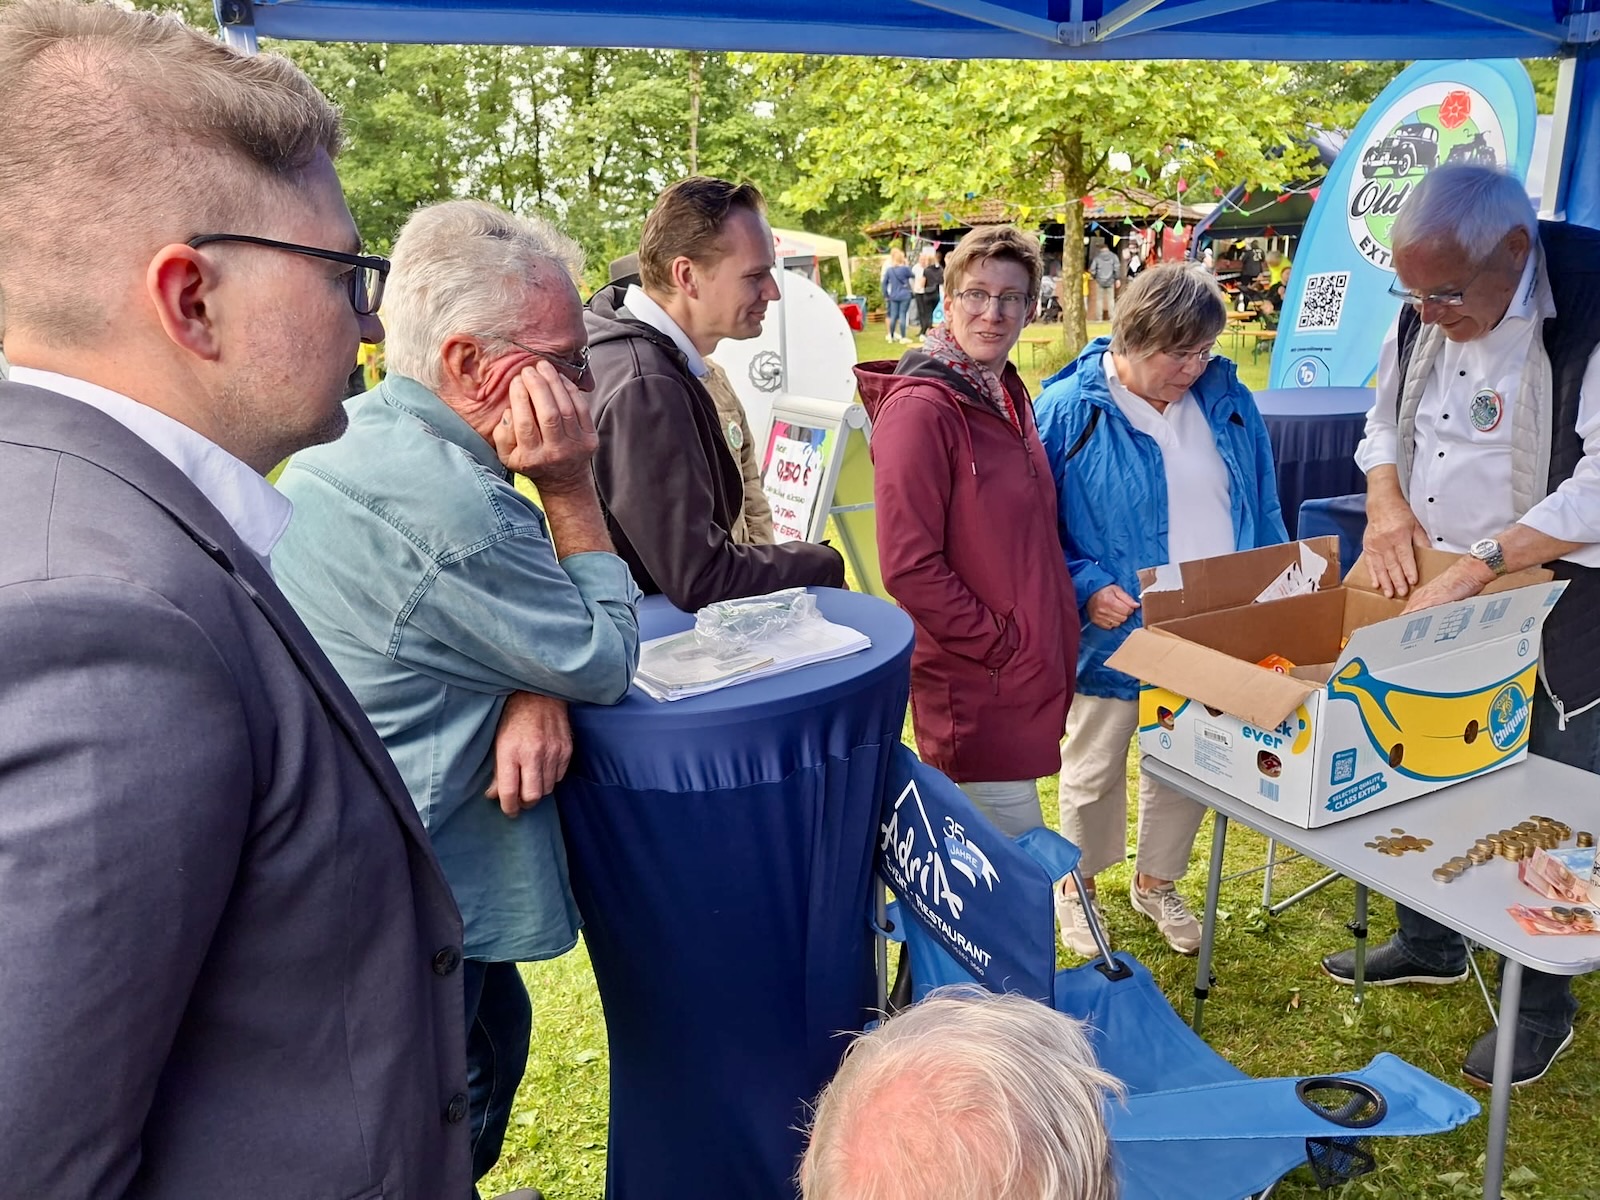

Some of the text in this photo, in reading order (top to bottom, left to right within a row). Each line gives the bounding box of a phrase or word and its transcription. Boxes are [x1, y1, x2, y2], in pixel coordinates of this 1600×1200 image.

[1242, 726, 1283, 749] ever
[1493, 704, 1529, 747] Chiquita
[1332, 775, 1381, 802] SELECTED QUALITY
[1334, 782, 1381, 810] CLASS EXTRA
[943, 816, 965, 846] 35
[950, 844, 979, 869] JAHRE
[915, 892, 992, 968] RESTAURANT
